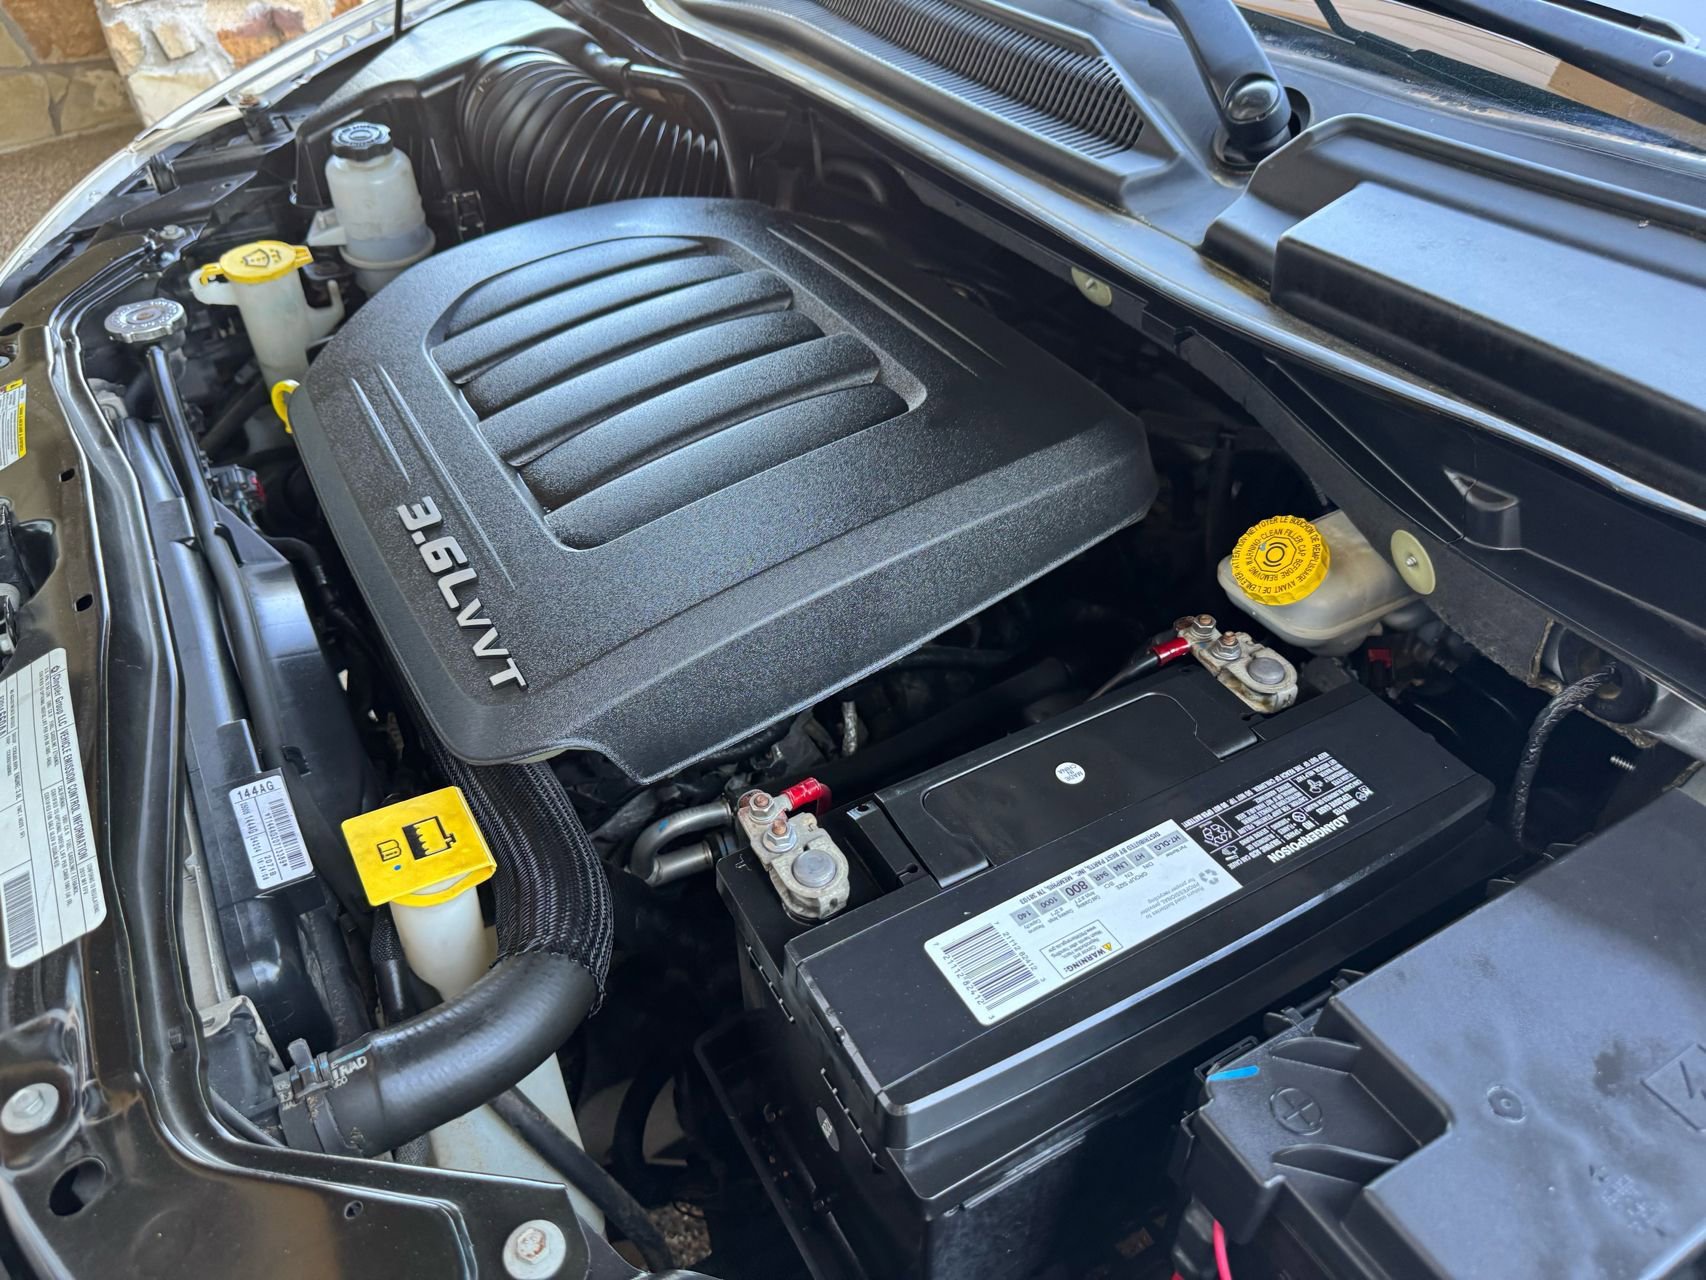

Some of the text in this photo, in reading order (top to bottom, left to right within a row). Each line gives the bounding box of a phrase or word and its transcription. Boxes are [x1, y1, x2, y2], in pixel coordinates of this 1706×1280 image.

[1260, 528, 1283, 540] CLEAN
[1284, 528, 1303, 544] FILLER
[1311, 533, 1320, 543] DE
[1297, 544, 1306, 556] CAP
[1280, 558, 1303, 578] BEFORE
[1274, 580, 1296, 593] AVANT
[456, 598, 527, 687] VVT
[54, 694, 65, 716] Group
[58, 712, 67, 727] LLC
[60, 727, 71, 755] VEHICLE
[63, 752, 76, 784] EMISSION
[237, 781, 274, 800] 144AG
[67, 782, 80, 815] CONTROL
[72, 812, 87, 862] INFORMATION
[1152, 834, 1181, 851] H7-DLG
[1267, 815, 1342, 863] DANGER/POISON
[1103, 851, 1119, 862] BEST
[1117, 847, 1127, 855] BY
[1132, 852, 1145, 861] H7
[1111, 860, 1129, 872] LN4
[1092, 870, 1109, 881] 94R
[1035, 888, 1046, 896] TN
[1063, 879, 1089, 897] 800
[1038, 895, 1058, 908] 1000
[1016, 909, 1031, 920] 140
[1062, 947, 1106, 973] WARNING:
